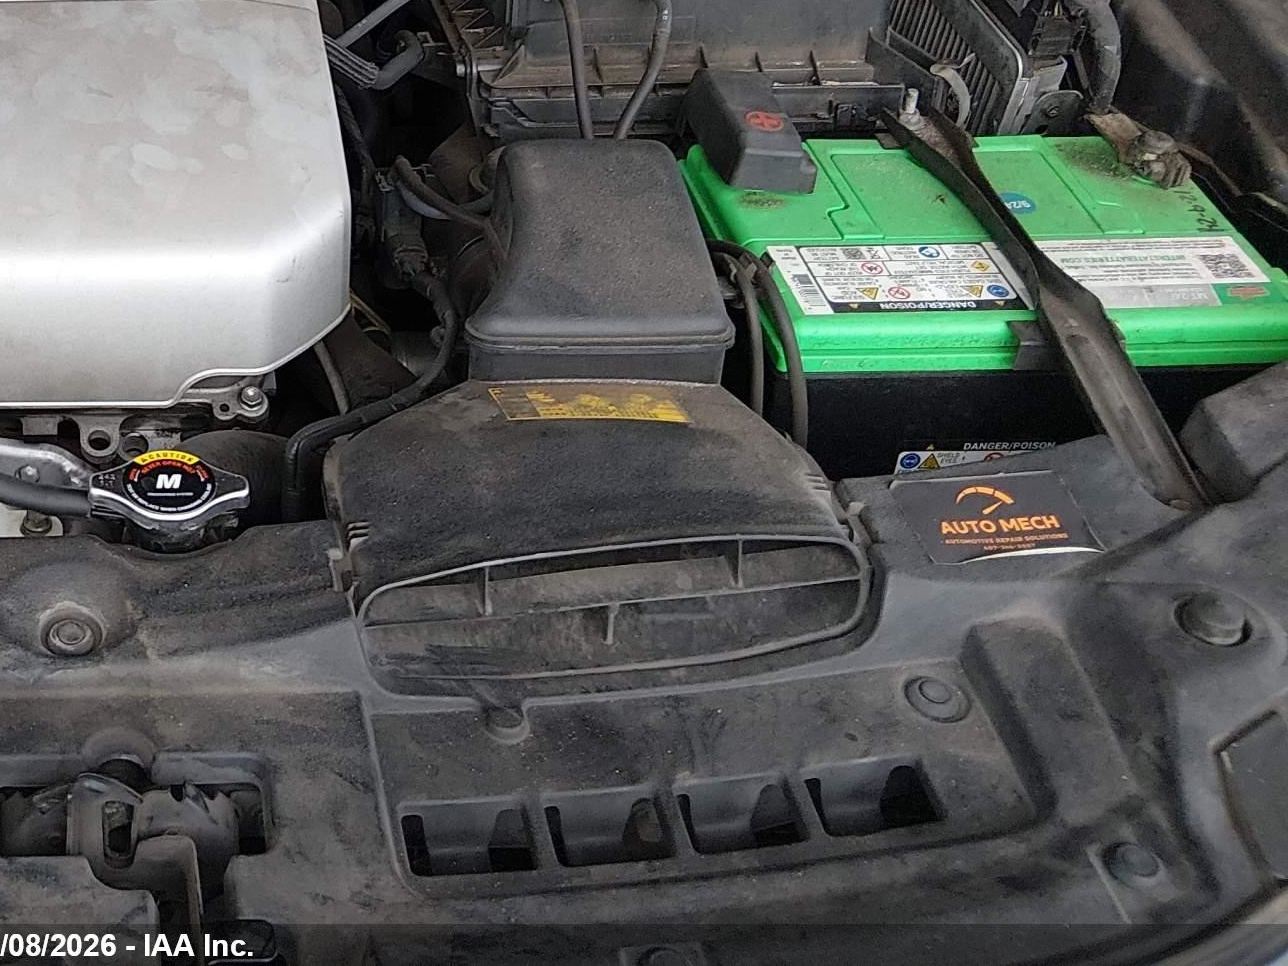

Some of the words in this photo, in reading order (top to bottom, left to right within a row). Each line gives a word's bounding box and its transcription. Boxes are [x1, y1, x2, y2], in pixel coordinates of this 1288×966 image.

[879, 300, 977, 311] DANGER/POISON
[963, 441, 1057, 451] DANGER/POISON
[148, 452, 194, 462] CAUTION
[155, 474, 182, 489] M
[940, 519, 997, 534] AUTO
[998, 514, 1061, 532] MECH
